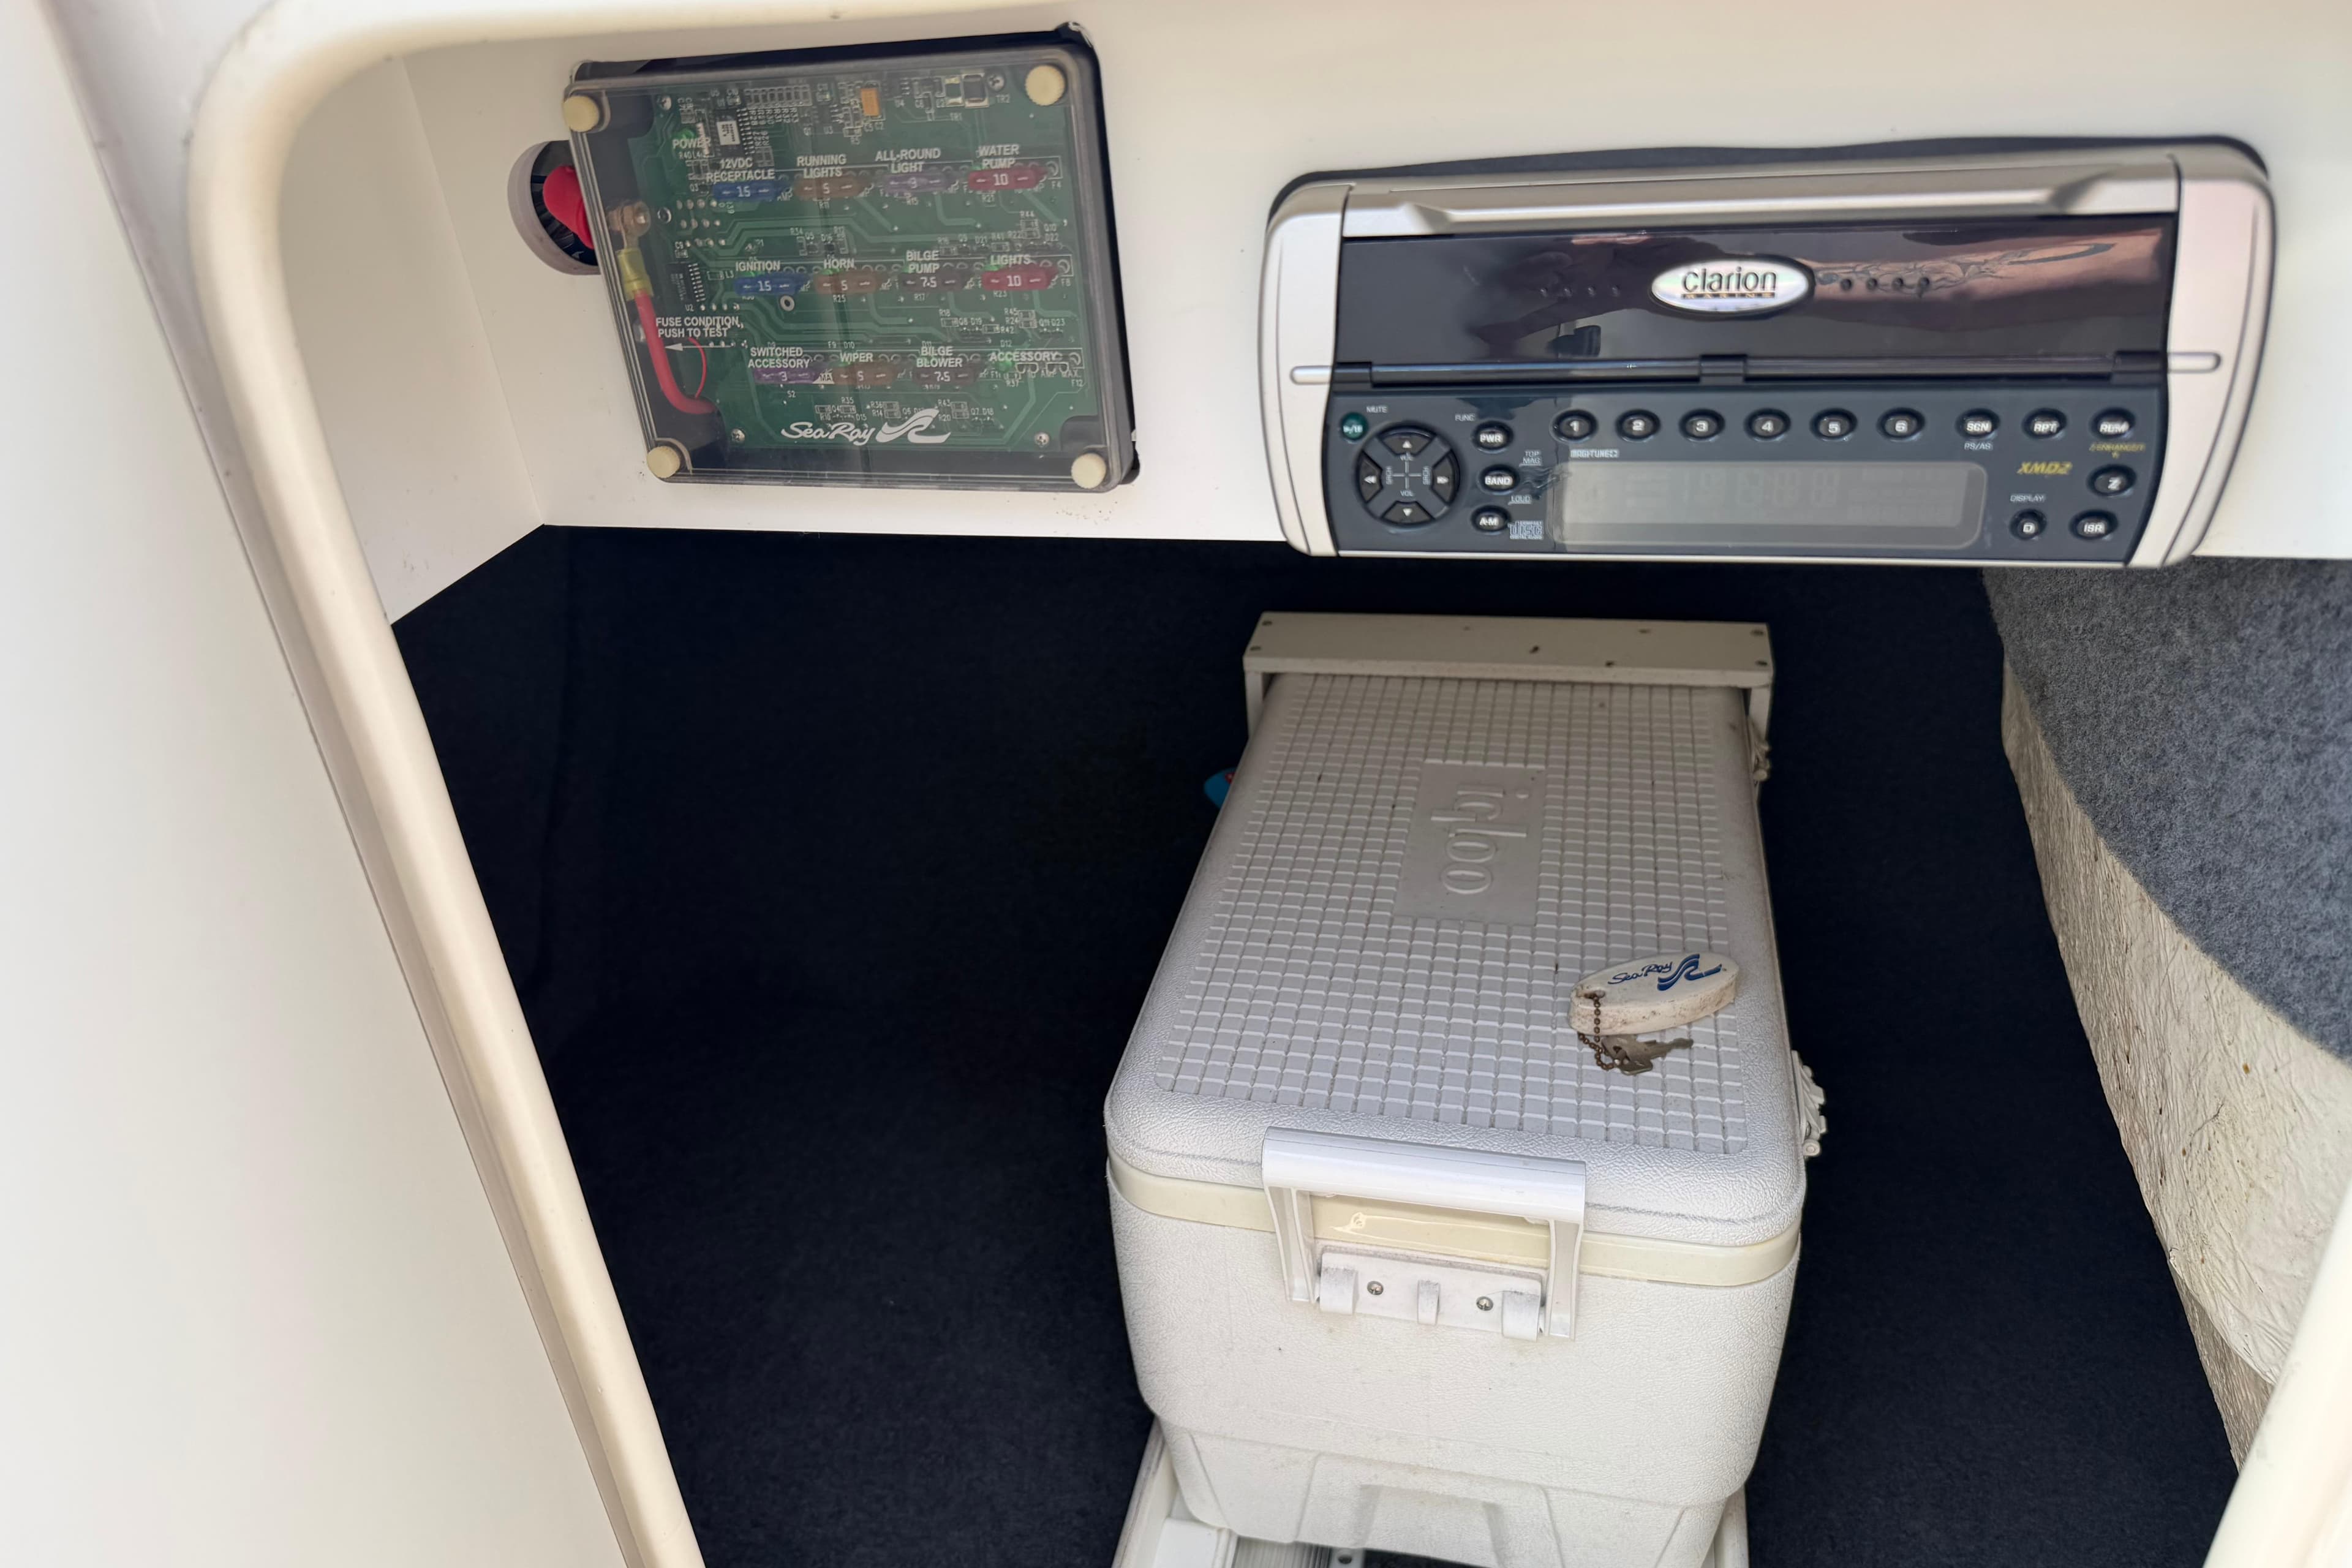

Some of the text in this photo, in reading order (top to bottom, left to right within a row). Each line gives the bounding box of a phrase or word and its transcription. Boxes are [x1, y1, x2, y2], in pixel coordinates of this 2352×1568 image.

[673, 137, 712, 149] POWER
[875, 148, 941, 162] ALL-ROUND
[978, 144, 1020, 157] WATER
[719, 157, 753, 168] 12VDC
[797, 154, 847, 167] RUNNING
[982, 157, 1016, 170] PUMP
[891, 161, 924, 173] LIGHT
[706, 169, 775, 183] RECEPTACLE
[803, 167, 843, 179] LIGHTS
[993, 173, 1009, 186] 10
[736, 186, 751, 198] 15
[906, 250, 940, 262] BILGE
[990, 254, 1031, 265] LIGHTS
[736, 260, 781, 271] IGNITION
[823, 258, 855, 269] HORN
[908, 263, 940, 274] PUMP
[920, 277, 937, 287] 7.5
[1006, 275, 1022, 287] 10
[1682, 266, 1777, 292] clarion
[757, 281, 771, 292] 15
[841, 280, 848, 291] 5
[656, 317, 682, 327] FUSE
[658, 328, 729, 338] PUSH TO TEST
[750, 347, 803, 356] SWITCHED
[921, 346, 953, 356] BILGE
[989, 351, 1057, 361] ACCESSORY
[748, 358, 810, 368] ACCESSORY
[840, 353, 873, 363] WIPER
[916, 358, 962, 368] BLOWER
[780, 371, 788, 382] 3
[858, 371, 864, 381] 5
[934, 371, 951, 382] 7.5
[1570, 420, 1579, 432] 1
[1632, 420, 1645, 431] 2
[1695, 421, 1709, 431] 3
[1762, 420, 1774, 432] 4
[1828, 421, 1841, 433] 5
[1895, 420, 1908, 432] 6
[1967, 421, 1992, 432] SCN
[2034, 421, 2060, 433] RPT
[2100, 421, 2130, 434] RDM
[1480, 433, 1504, 443] PWR
[1964, 442, 1993, 450] PS/AS
[2017, 461, 2073, 475] XMD2
[1485, 476, 1513, 485] BAND
[2108, 477, 2122, 490] Z
[2010, 494, 2046, 502] DISPLAY
[2023, 522, 2037, 533] D
[2084, 522, 2106, 534] ISR
